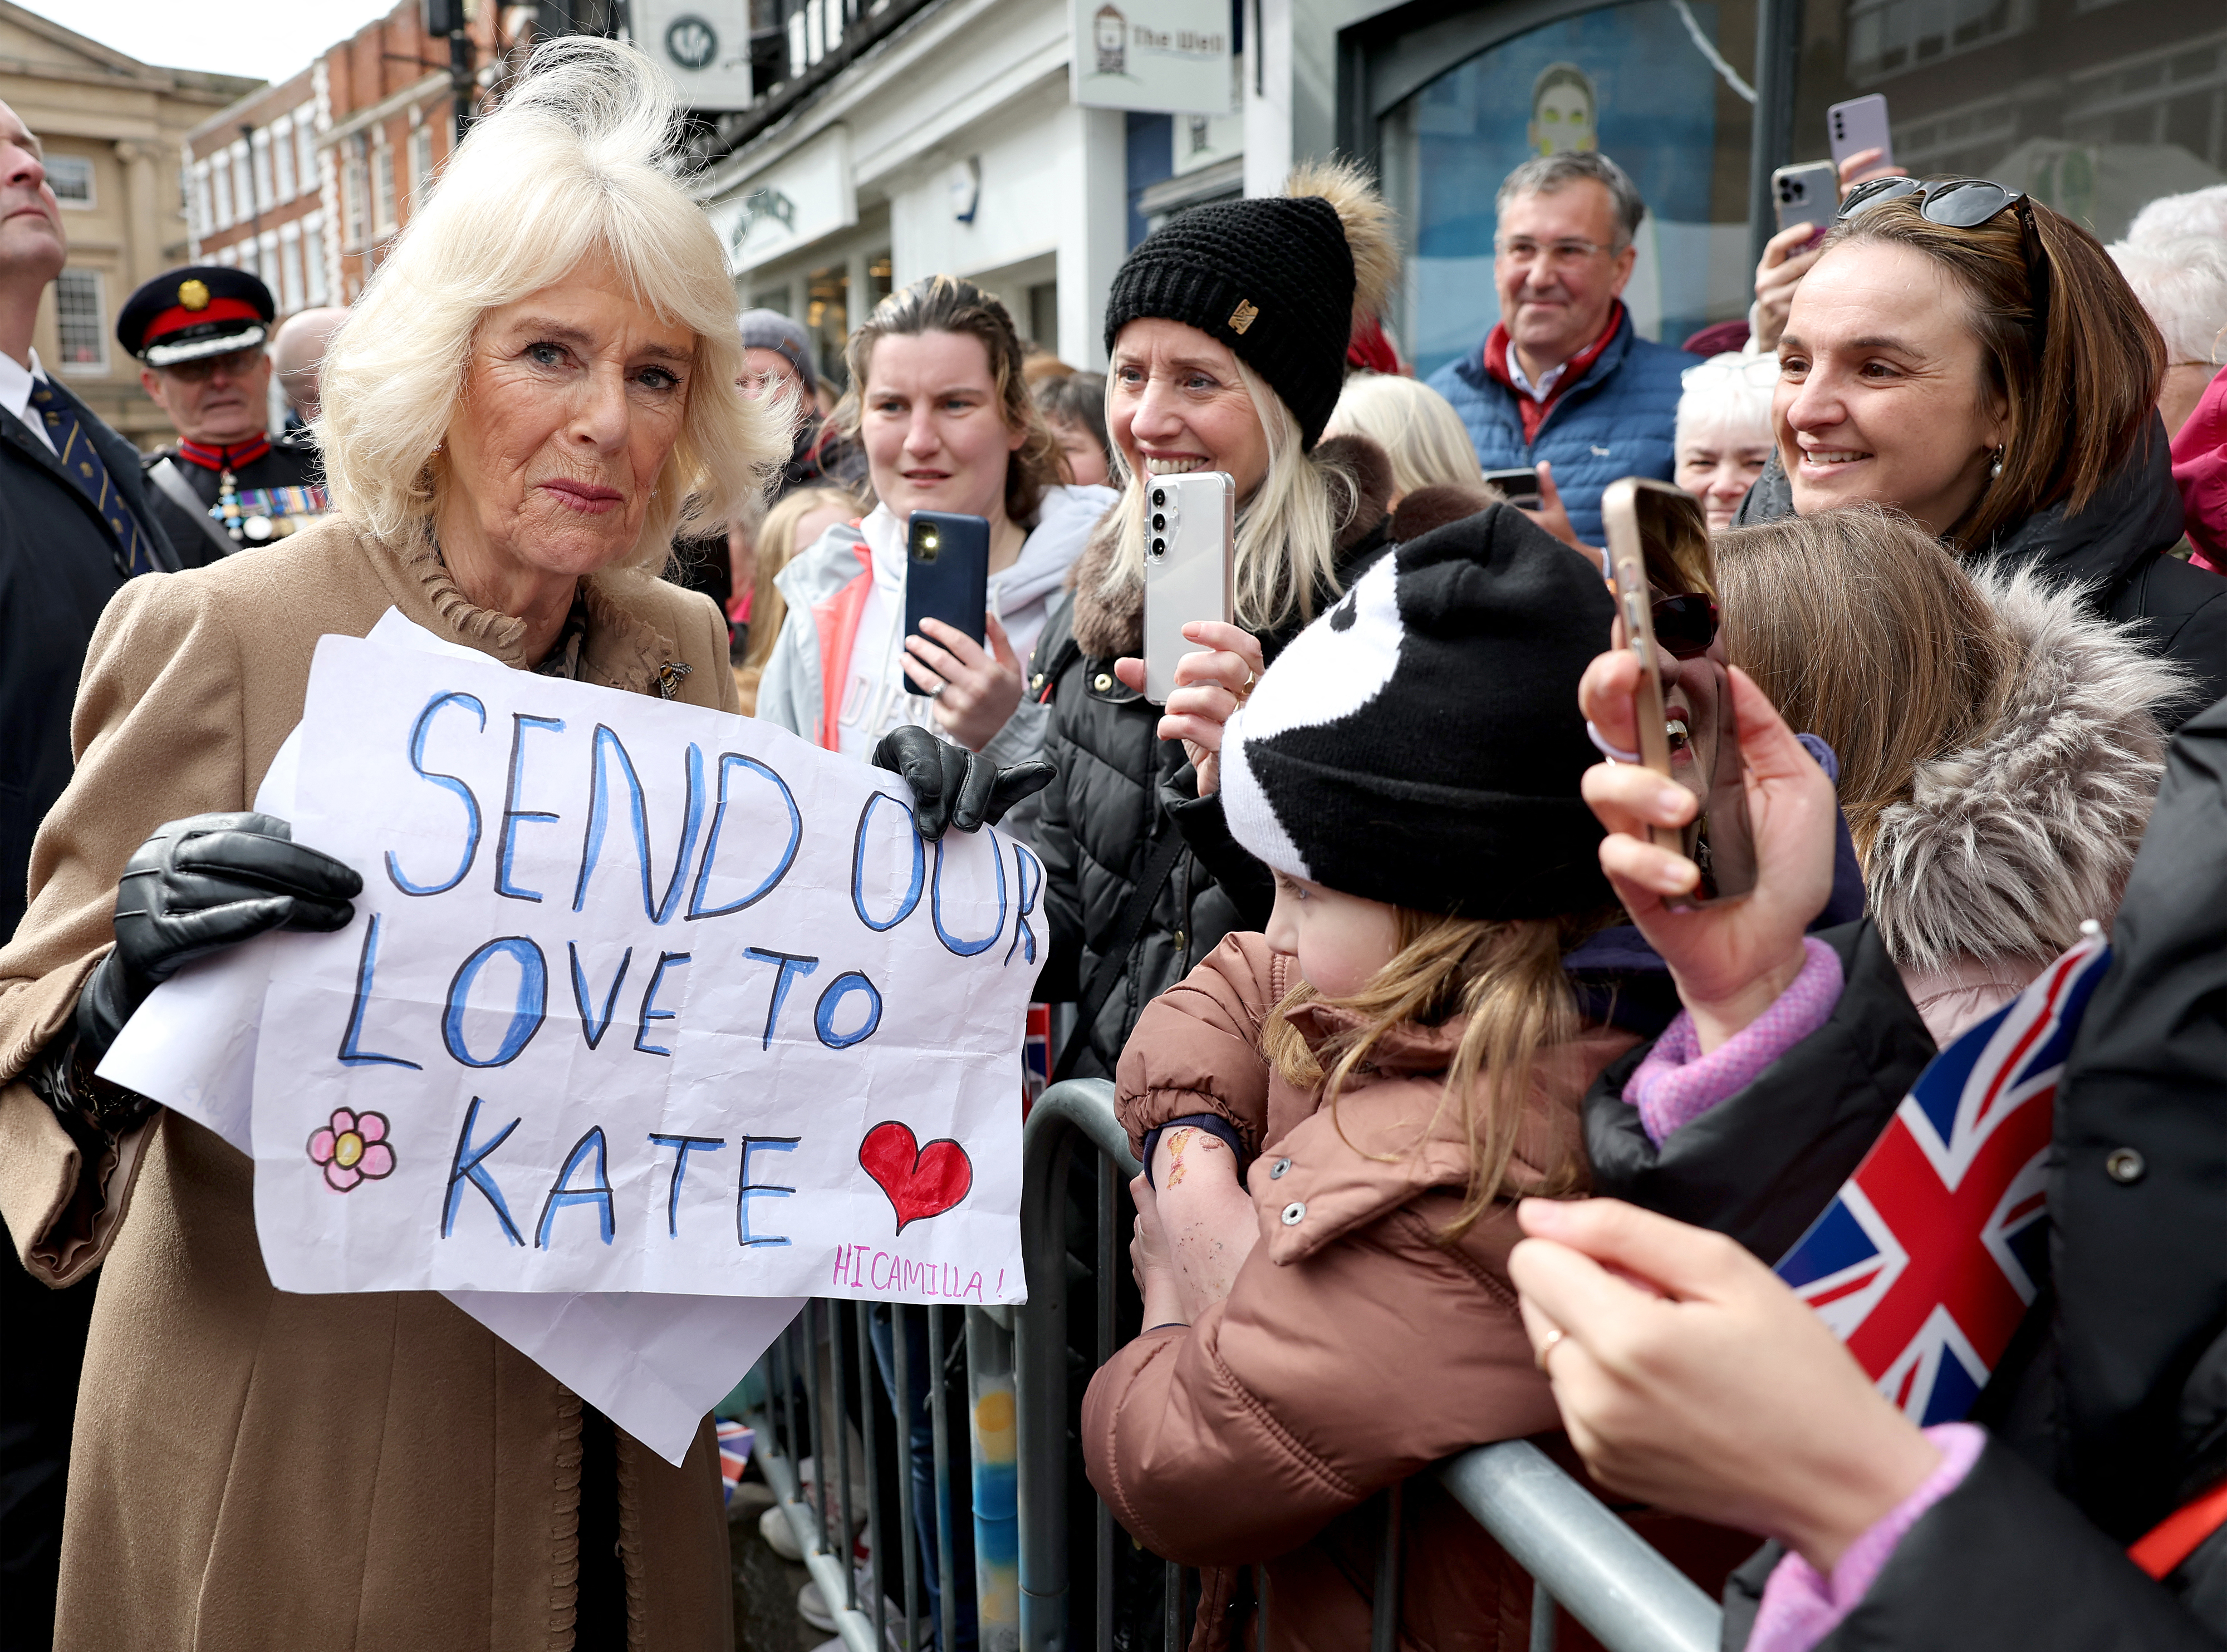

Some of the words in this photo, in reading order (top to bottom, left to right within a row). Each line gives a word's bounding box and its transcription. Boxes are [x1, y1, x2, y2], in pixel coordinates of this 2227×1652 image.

[1134, 25, 1170, 47] The
[1176, 30, 1224, 52] Well
[384, 689, 803, 926] SEND
[851, 790, 1041, 967] OUR
[337, 912, 692, 1070] LOVE
[743, 946, 882, 1050] TO
[441, 1095, 802, 1251] KATE
[833, 1242, 870, 1287] HI
